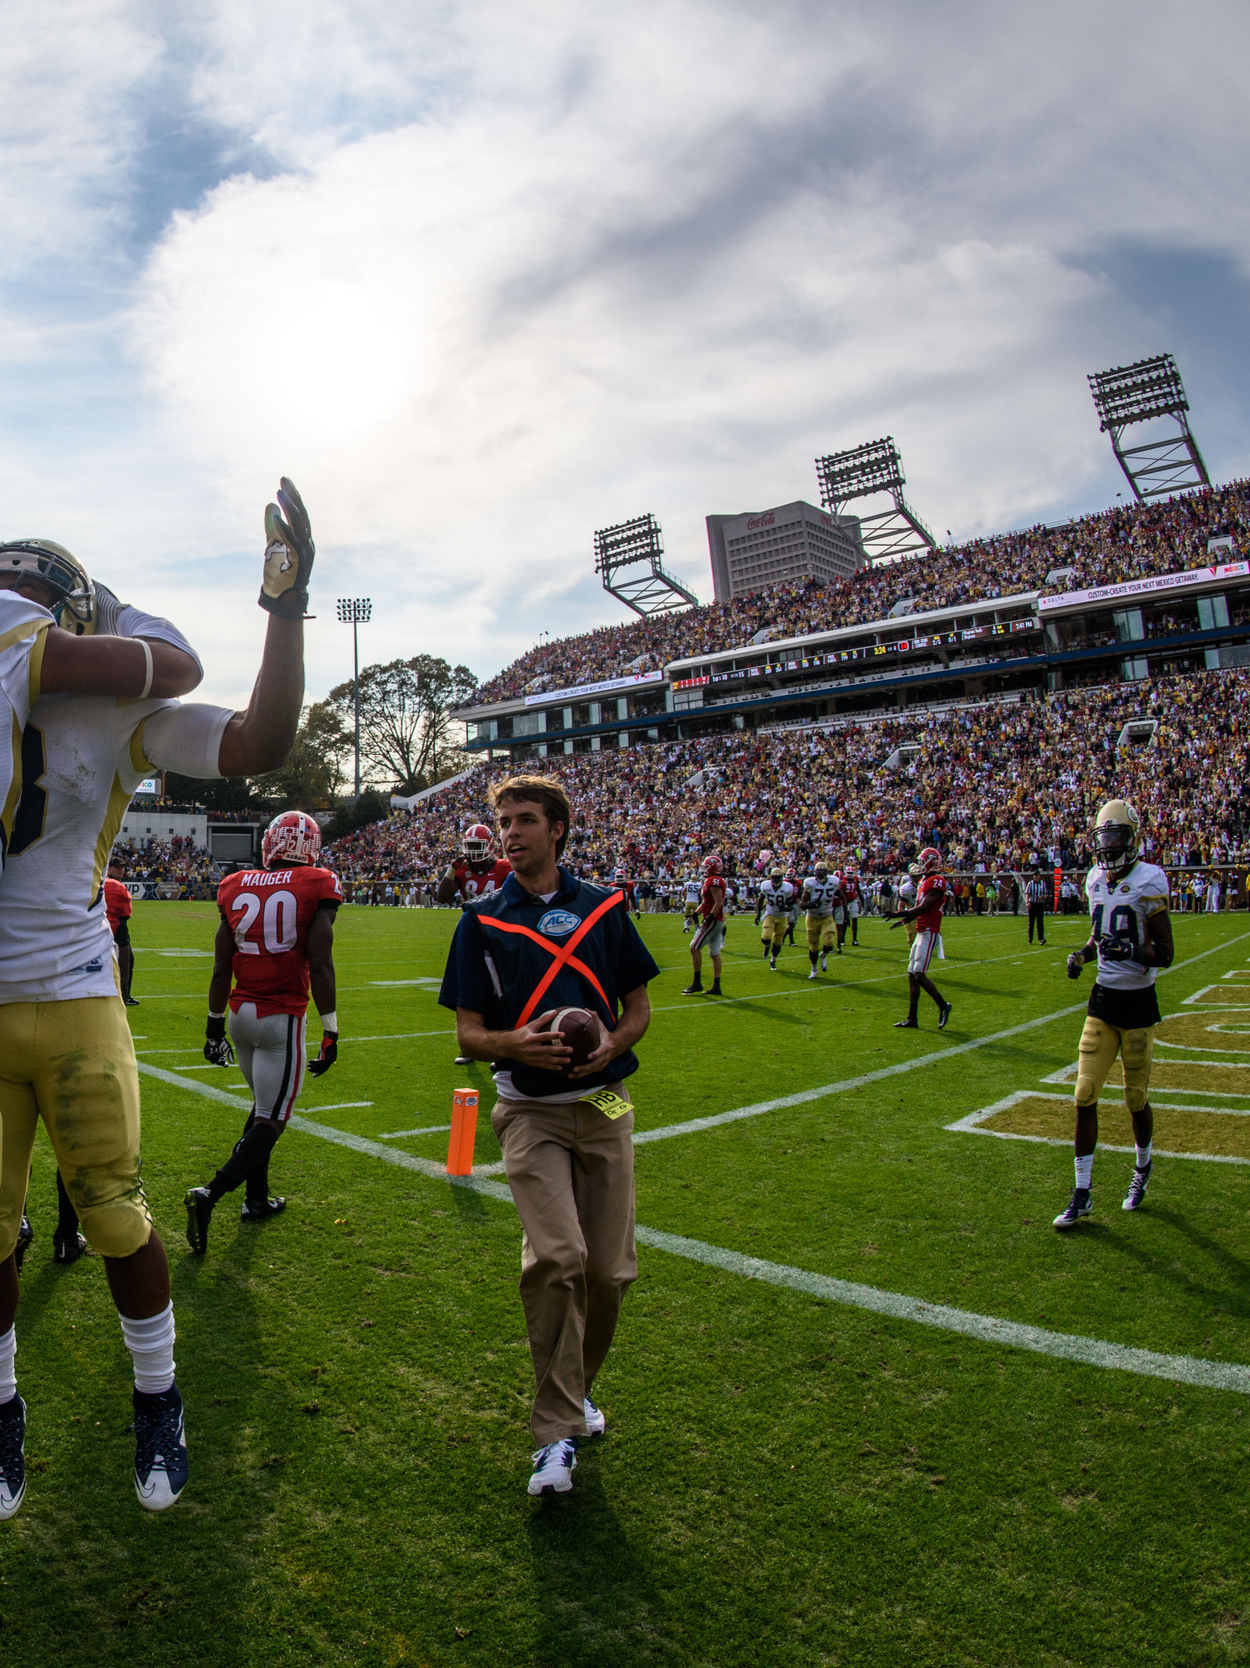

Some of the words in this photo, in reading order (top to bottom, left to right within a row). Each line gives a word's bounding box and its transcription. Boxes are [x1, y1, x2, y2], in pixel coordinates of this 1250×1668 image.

[1088, 587, 1128, 600] CUSTOM-CREATE
[1128, 583, 1142, 594] YOUR
[1142, 581, 1155, 591] NEXT
[1155, 578, 1174, 588] MEXICO
[241, 870, 293, 887] MAUGER
[933, 879, 943, 888] 24
[465, 880, 496, 901] 84
[688, 884, 699, 893] 65
[232, 890, 297, 955] 20
[545, 915, 573, 928] ACC
[589, 1092, 617, 1107] HB
